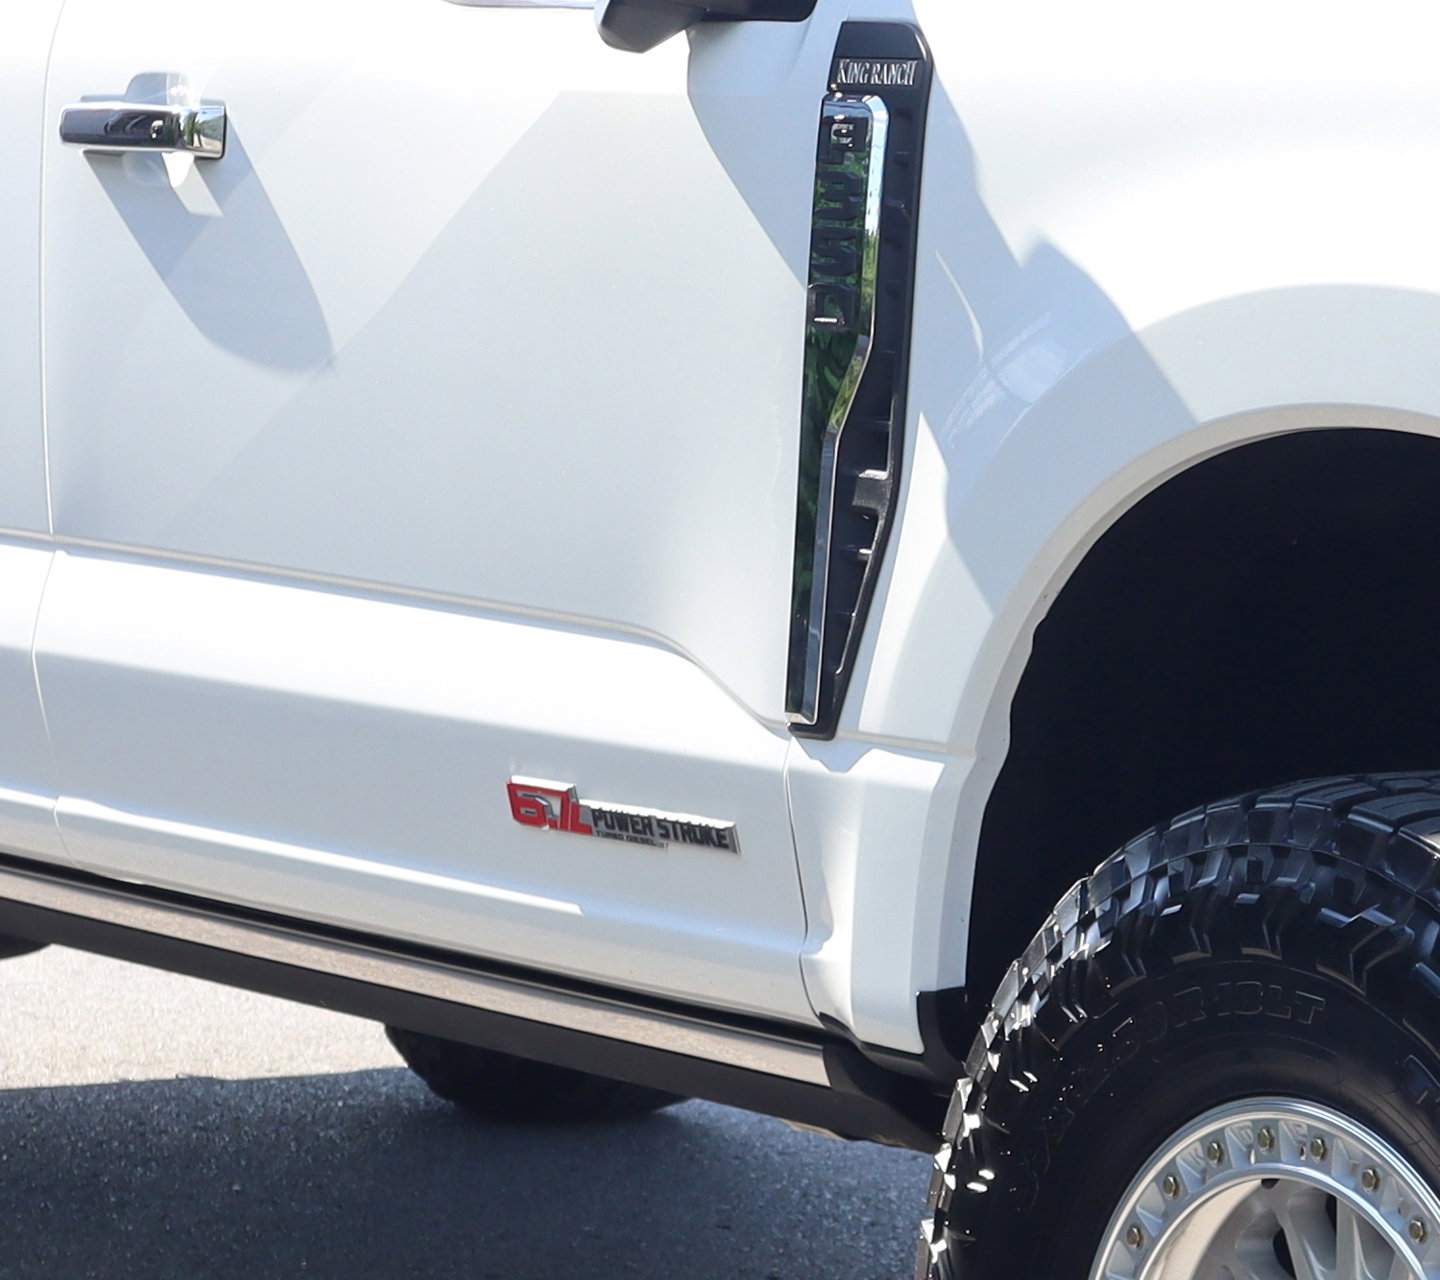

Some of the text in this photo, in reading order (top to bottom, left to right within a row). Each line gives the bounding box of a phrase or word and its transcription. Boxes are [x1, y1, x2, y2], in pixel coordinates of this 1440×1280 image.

[837, 59, 918, 86] KING RANCH
[591, 806, 731, 850] POWER STROKE
